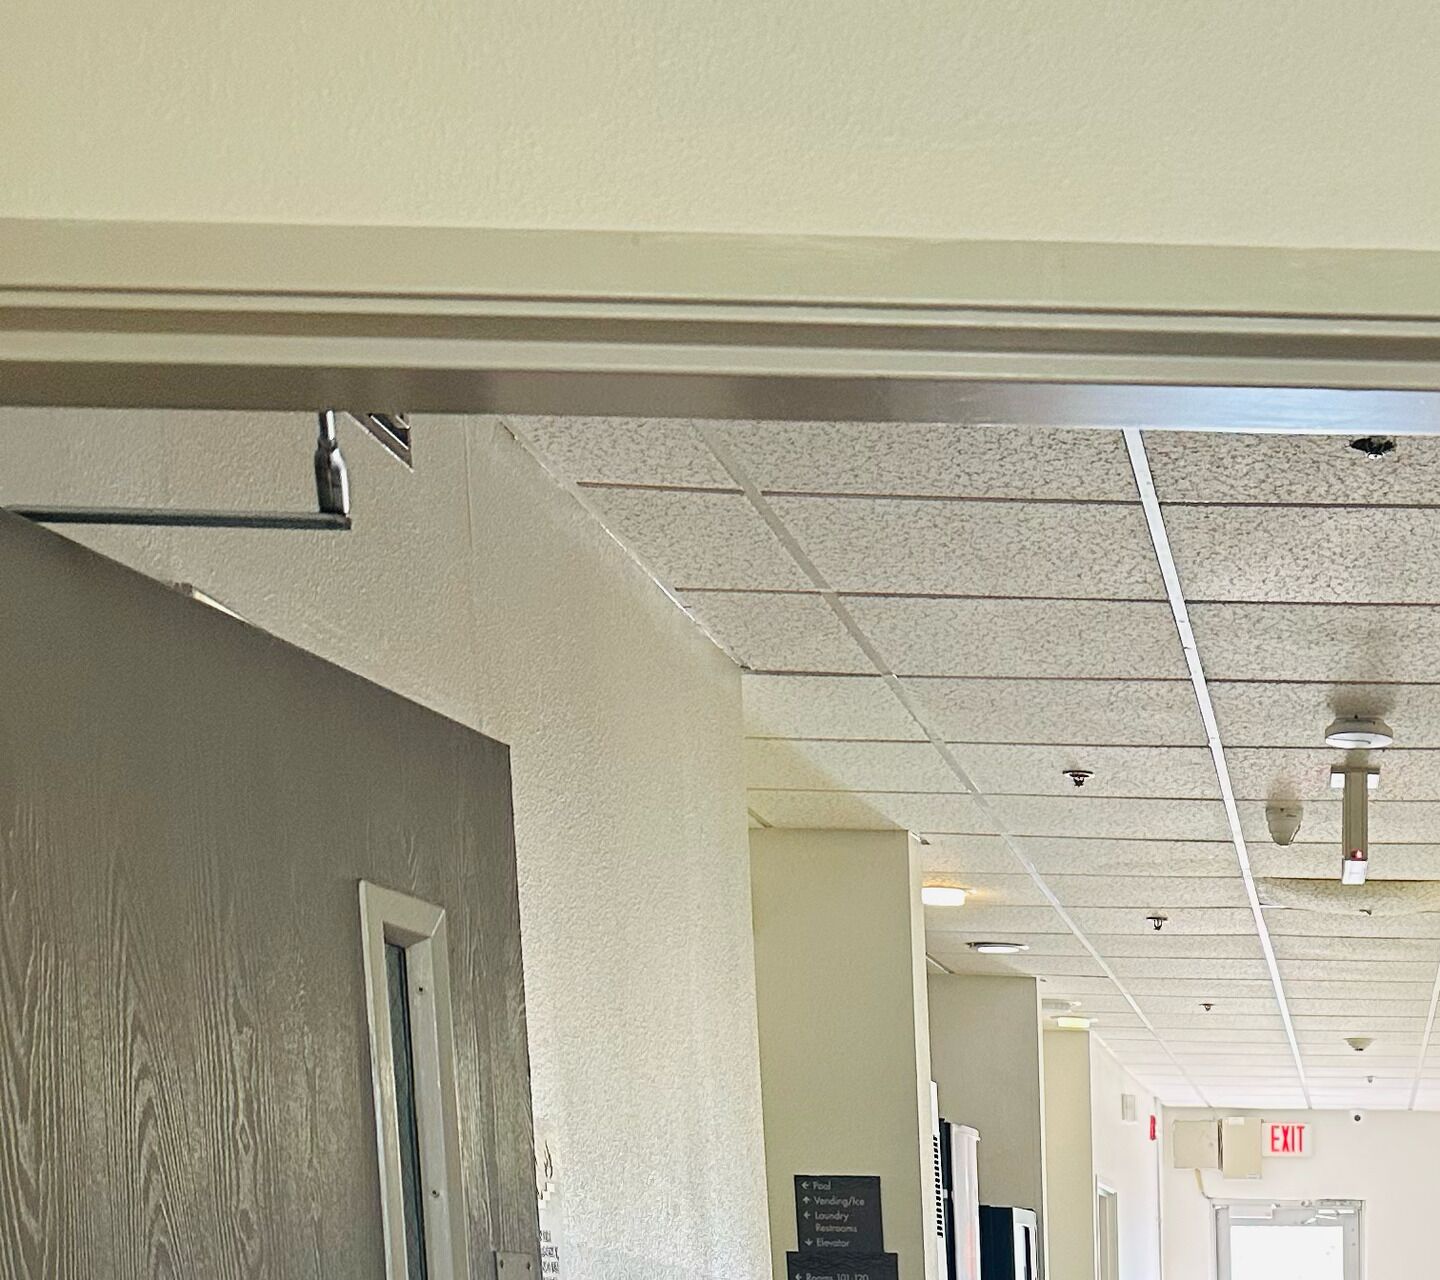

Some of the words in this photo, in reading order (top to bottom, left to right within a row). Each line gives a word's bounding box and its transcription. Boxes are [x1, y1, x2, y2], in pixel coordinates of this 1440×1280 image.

[1271, 1125, 1305, 1152] EXIT
[813, 1181, 831, 1190] Pool
[814, 1196, 865, 1207] Vending/Ice
[815, 1211, 849, 1221] Laundry
[816, 1224, 857, 1233] Restrooms
[816, 1238, 850, 1247] Elevator
